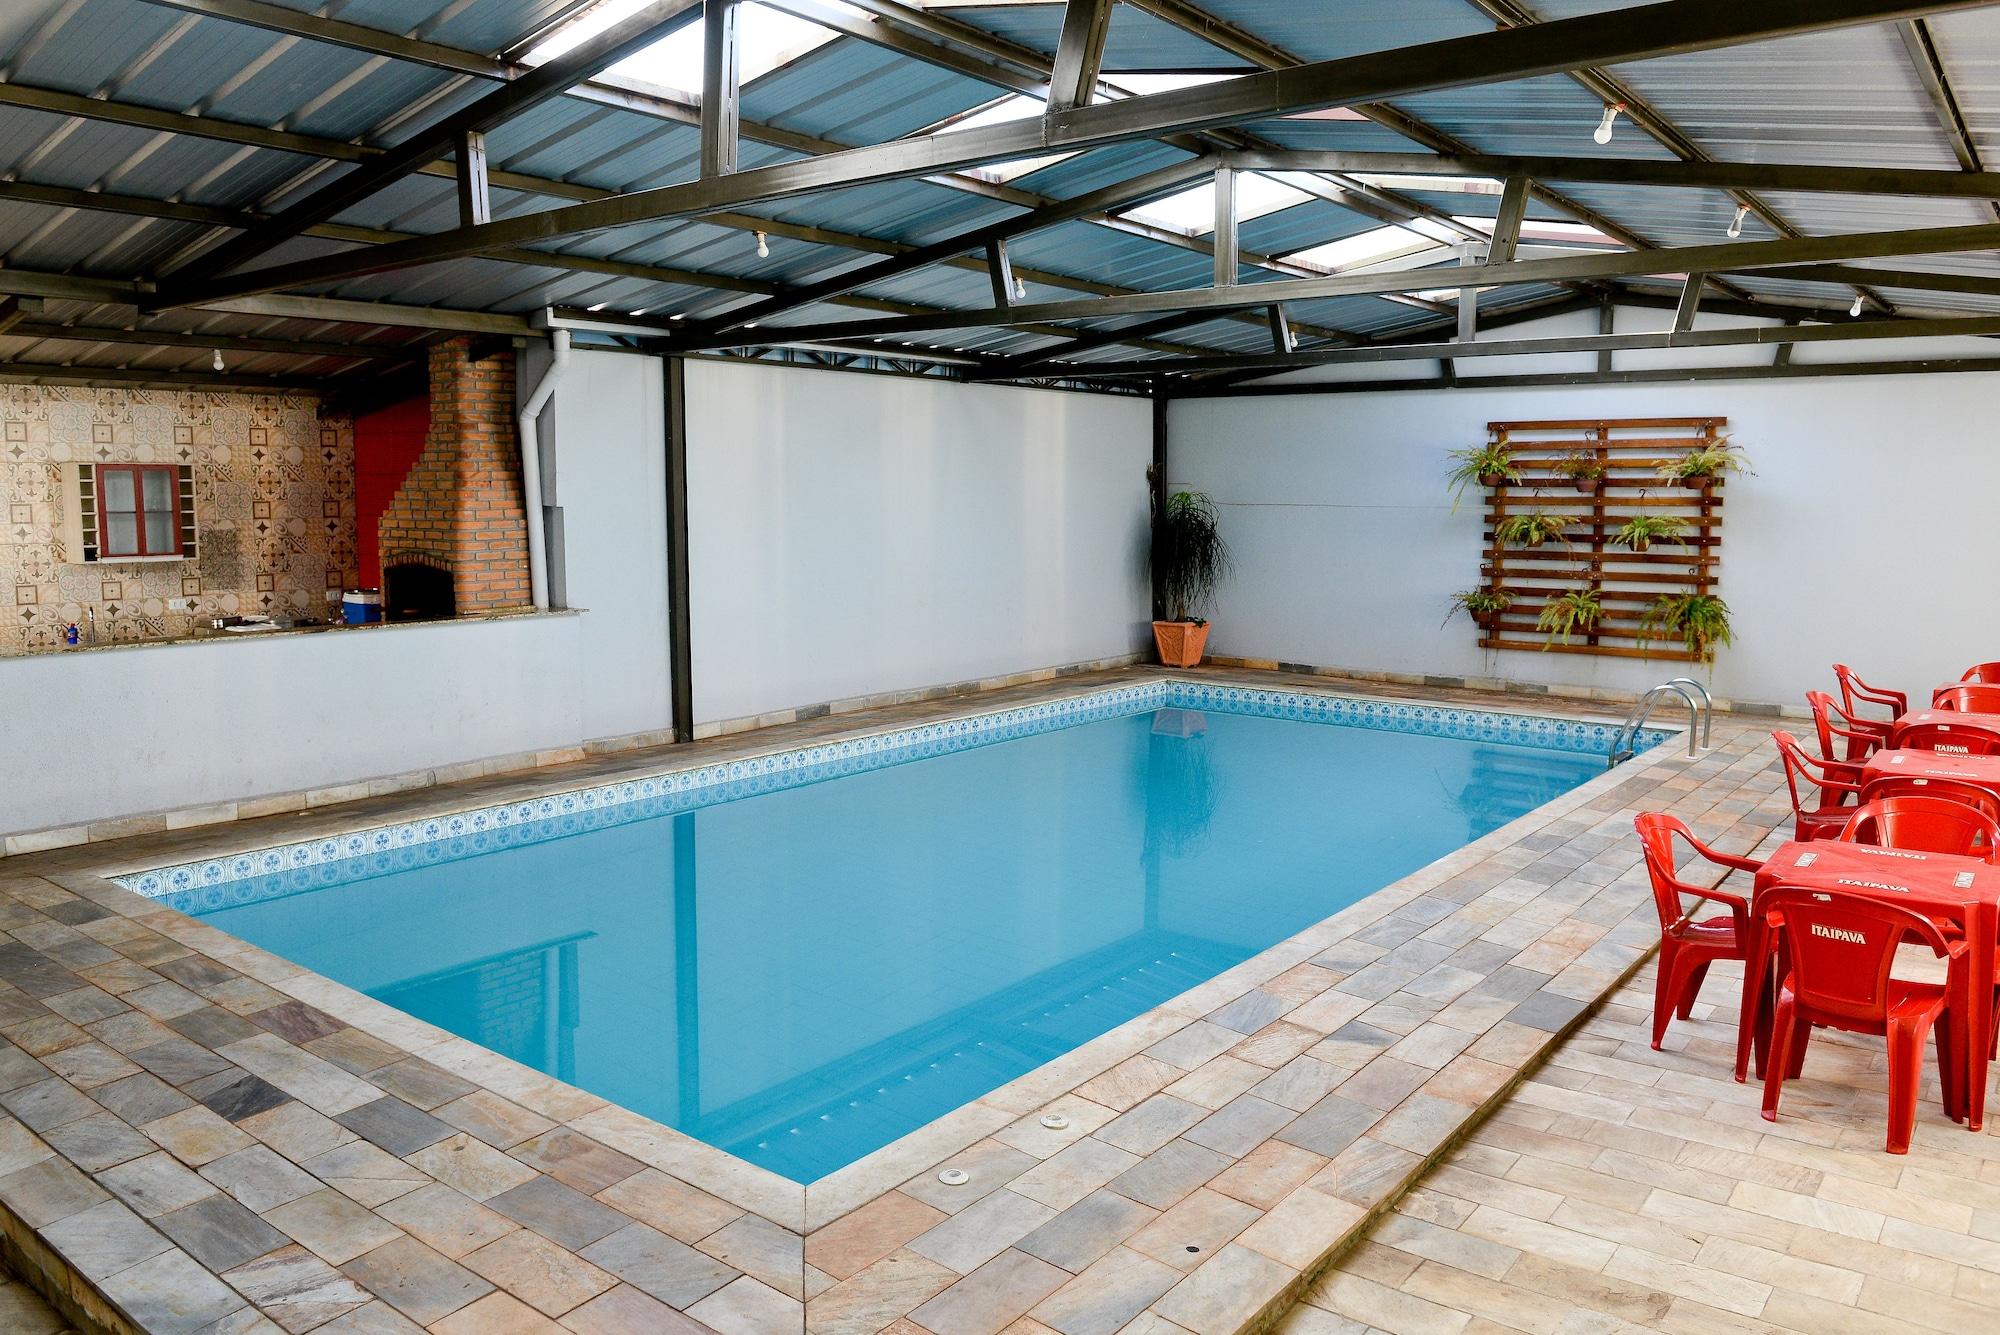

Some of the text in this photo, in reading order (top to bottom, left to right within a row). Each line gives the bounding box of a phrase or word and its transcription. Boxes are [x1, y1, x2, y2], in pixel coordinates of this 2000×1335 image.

[1934, 744, 1968, 753] ITAIPAVA
[1838, 879, 1910, 893] ITAIPAVA
[1811, 924, 1866, 945] ITAIPAVA
